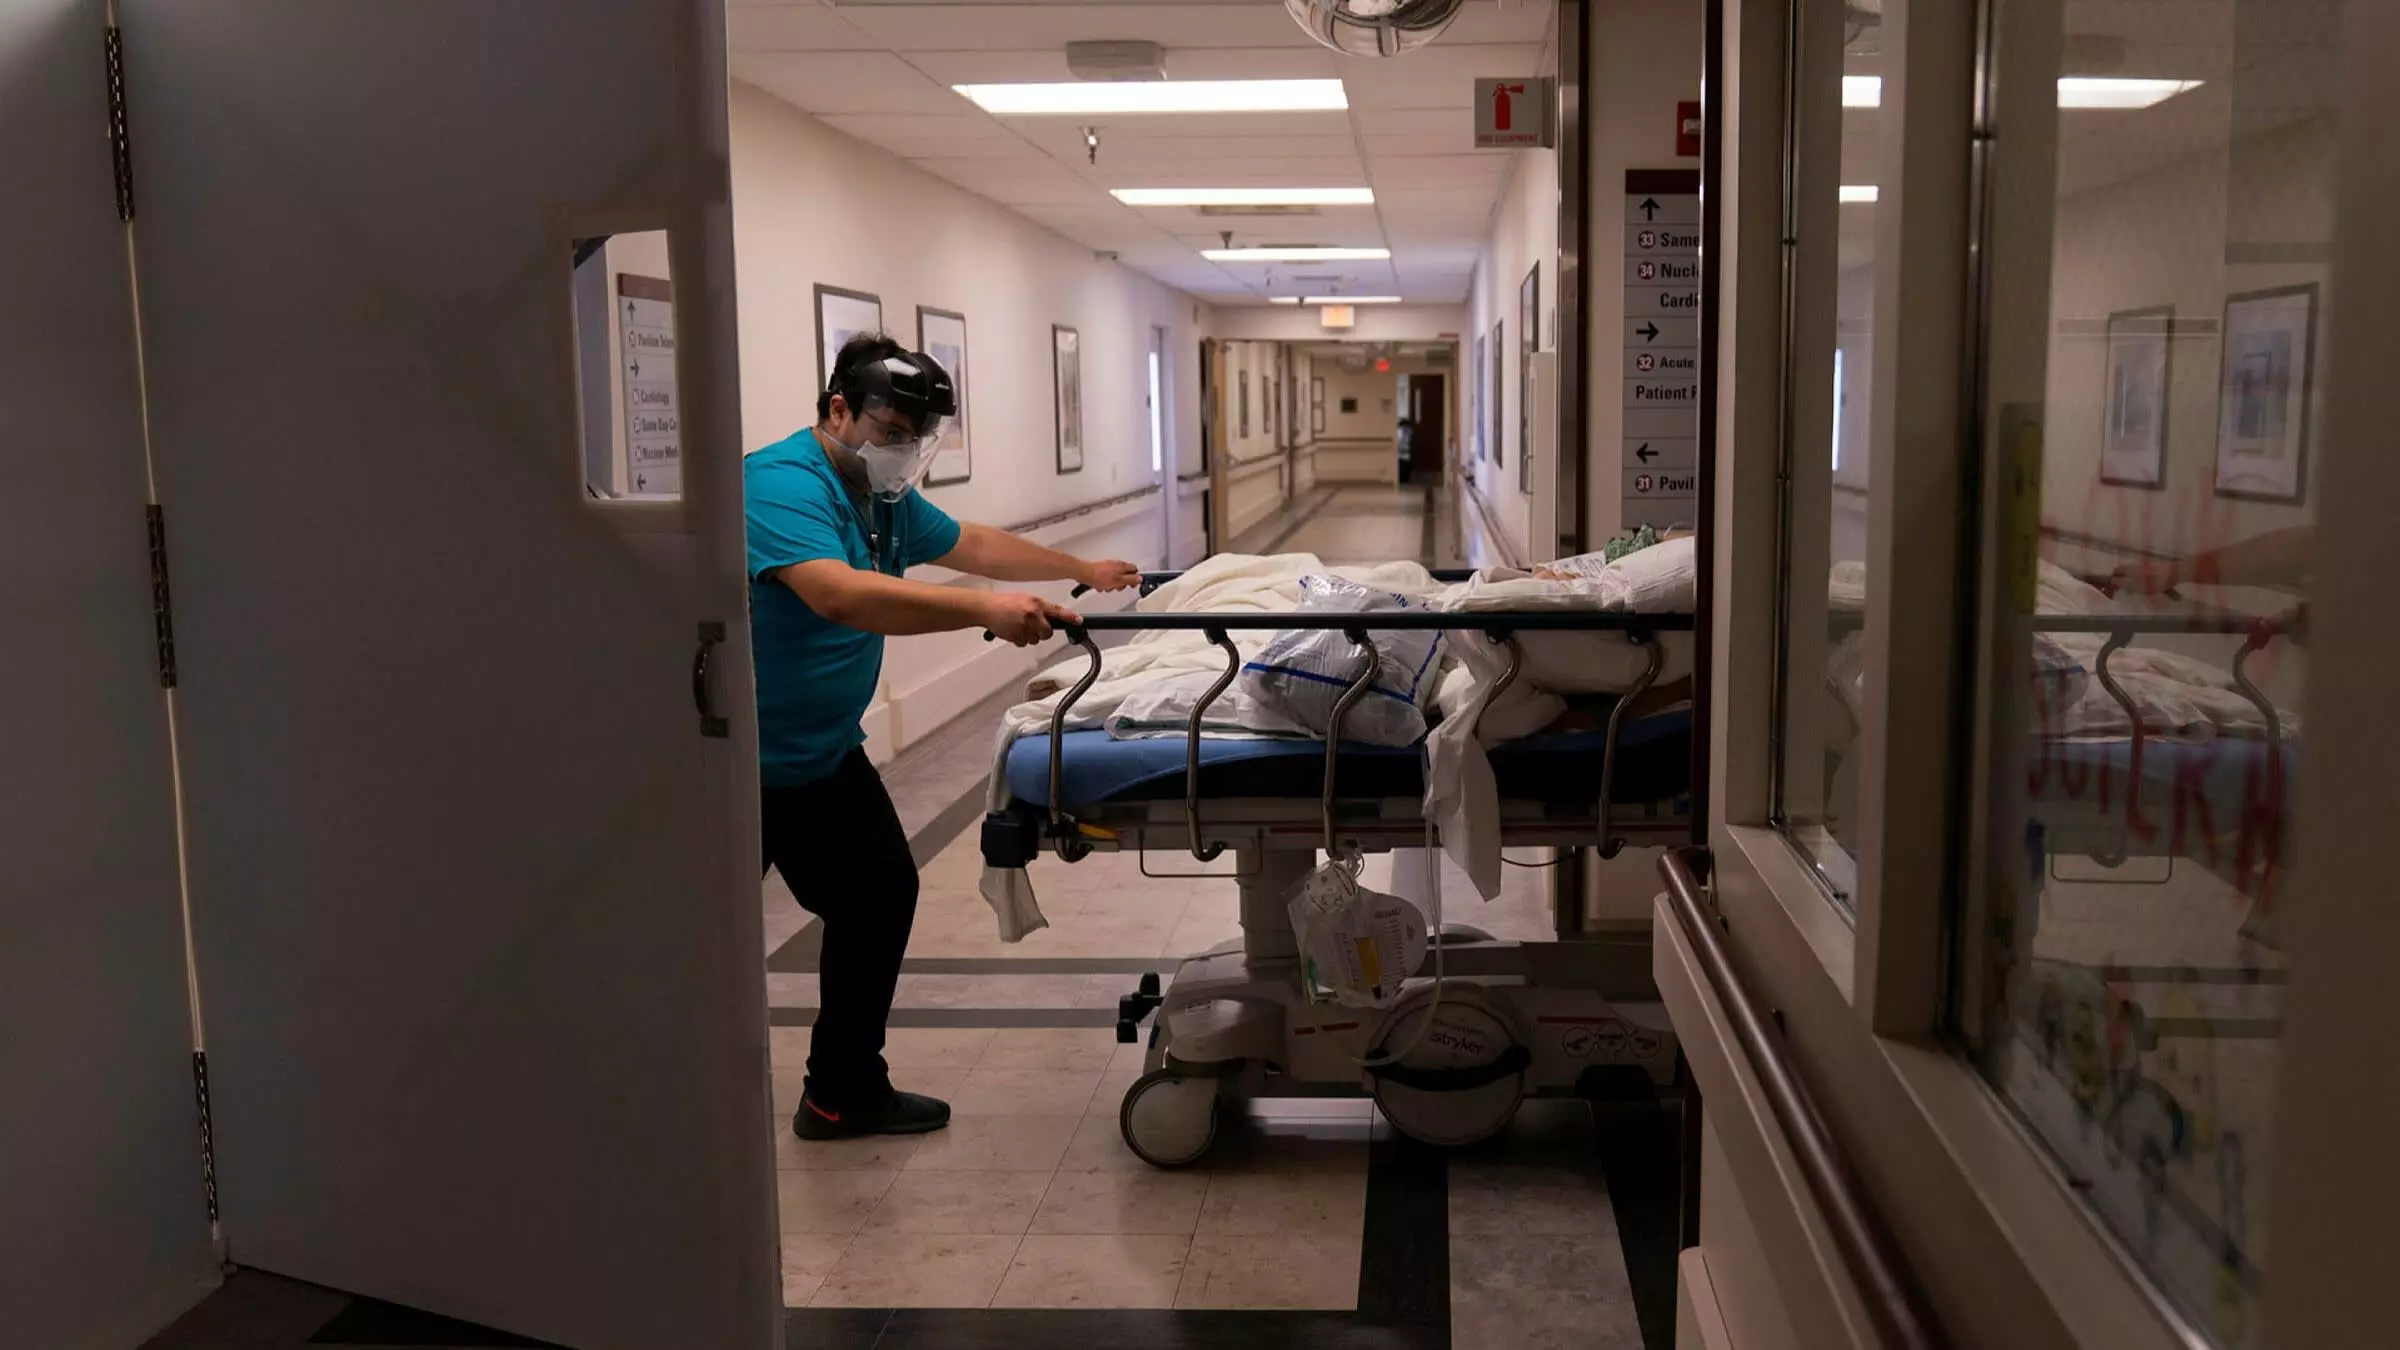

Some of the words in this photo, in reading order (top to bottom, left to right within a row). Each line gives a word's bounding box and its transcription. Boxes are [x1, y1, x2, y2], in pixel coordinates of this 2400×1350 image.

[1640, 233, 1654, 246] 33
[1640, 264, 1654, 278] 34
[1661, 262, 1699, 278] Nucl
[1660, 292, 1698, 308] Cardi
[1639, 356, 1652, 369] 32
[1660, 356, 1694, 369] Acute
[1636, 384, 1687, 400] Patient
[1638, 476, 1650, 490] 31
[1660, 475, 1694, 491] Pavil
[1430, 1032, 1485, 1056] stryker
